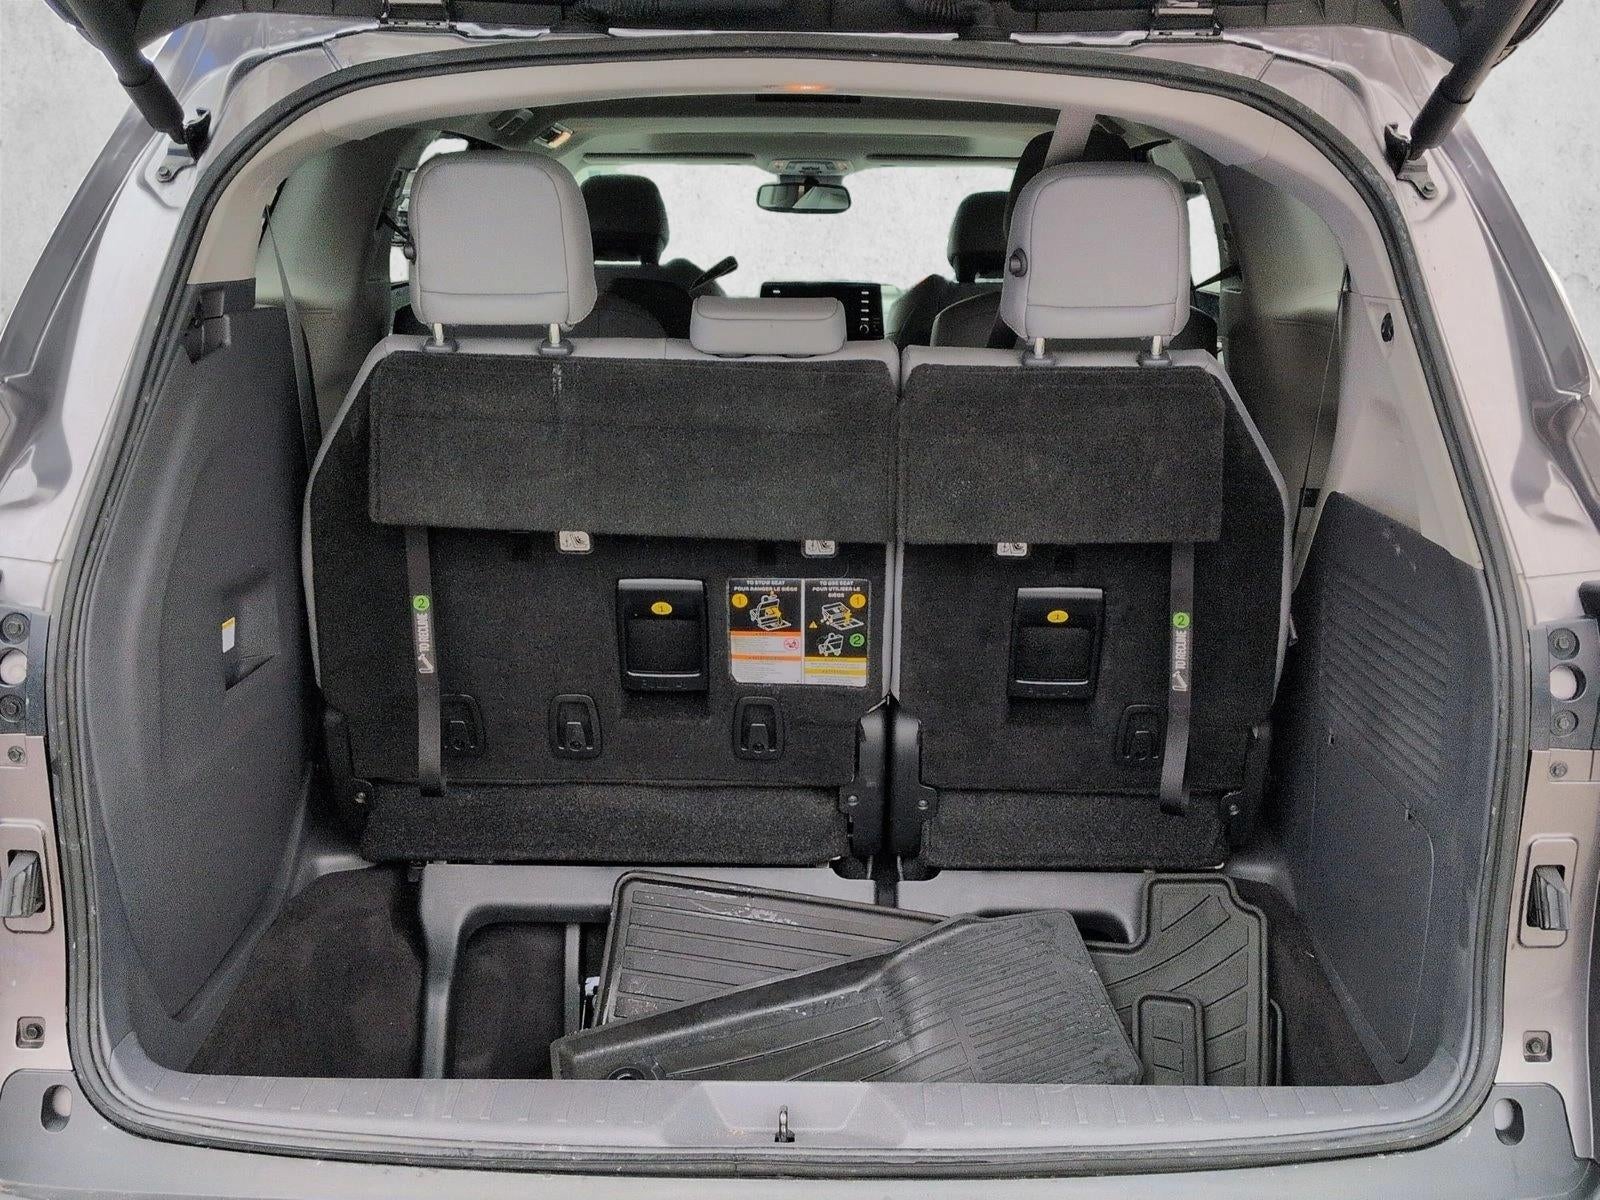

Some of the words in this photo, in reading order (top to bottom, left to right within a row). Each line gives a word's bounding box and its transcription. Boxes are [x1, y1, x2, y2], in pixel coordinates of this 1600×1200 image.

[418, 598, 425, 609] 2
[1178, 615, 1185, 625] 2
[416, 613, 430, 642] RECLINE
[854, 634, 862, 645] 2
[1175, 630, 1187, 659] RECLINE
[418, 643, 430, 653] TO
[1175, 660, 1186, 670] TO
